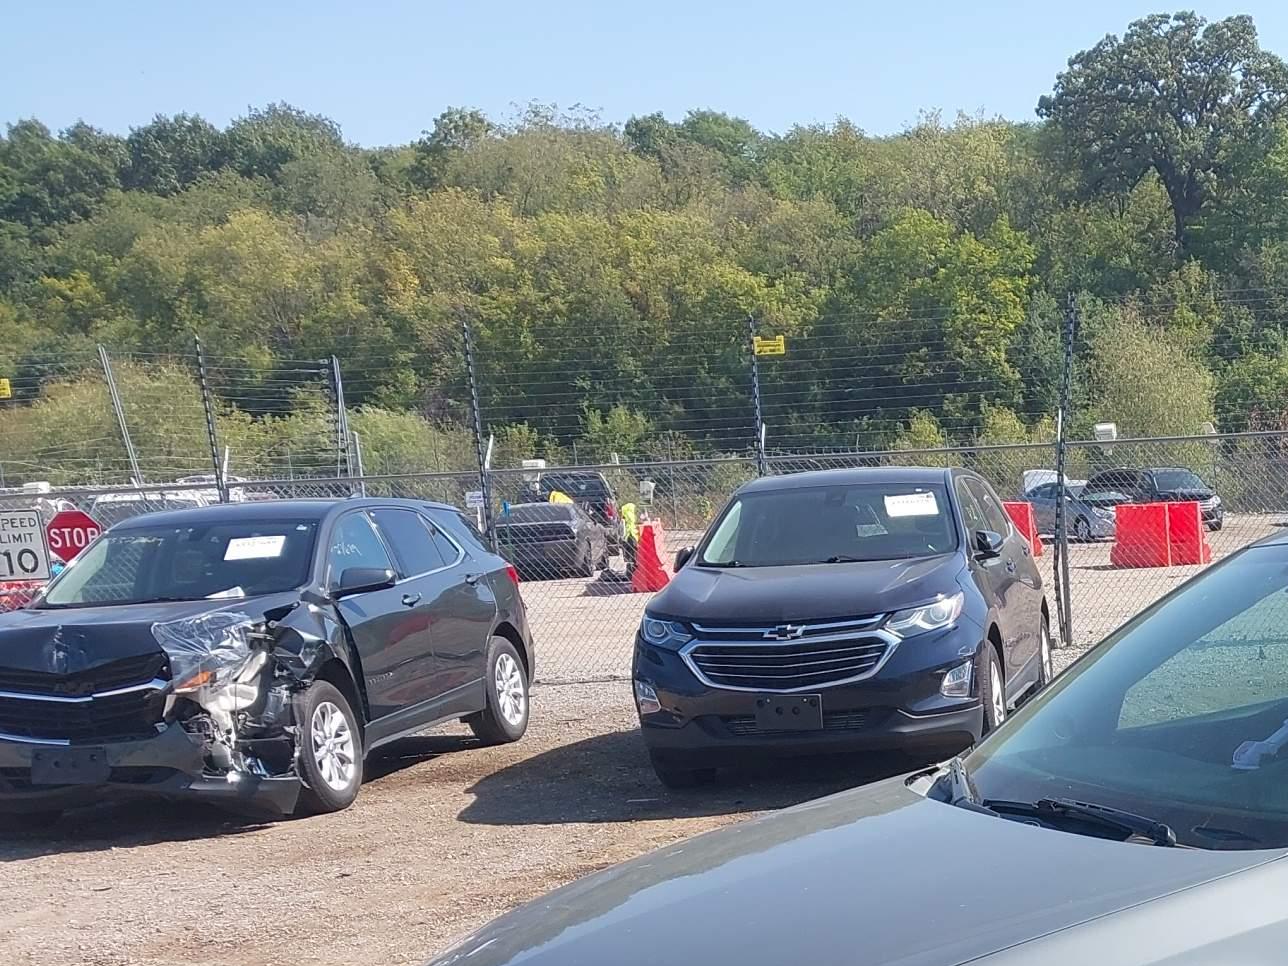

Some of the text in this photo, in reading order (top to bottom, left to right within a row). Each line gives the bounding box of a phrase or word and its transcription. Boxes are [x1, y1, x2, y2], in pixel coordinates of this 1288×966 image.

[1, 517, 37, 531] PEED
[0, 532, 34, 544] LIMIT
[49, 527, 99, 548] STOP
[0, 548, 39, 576] 10
